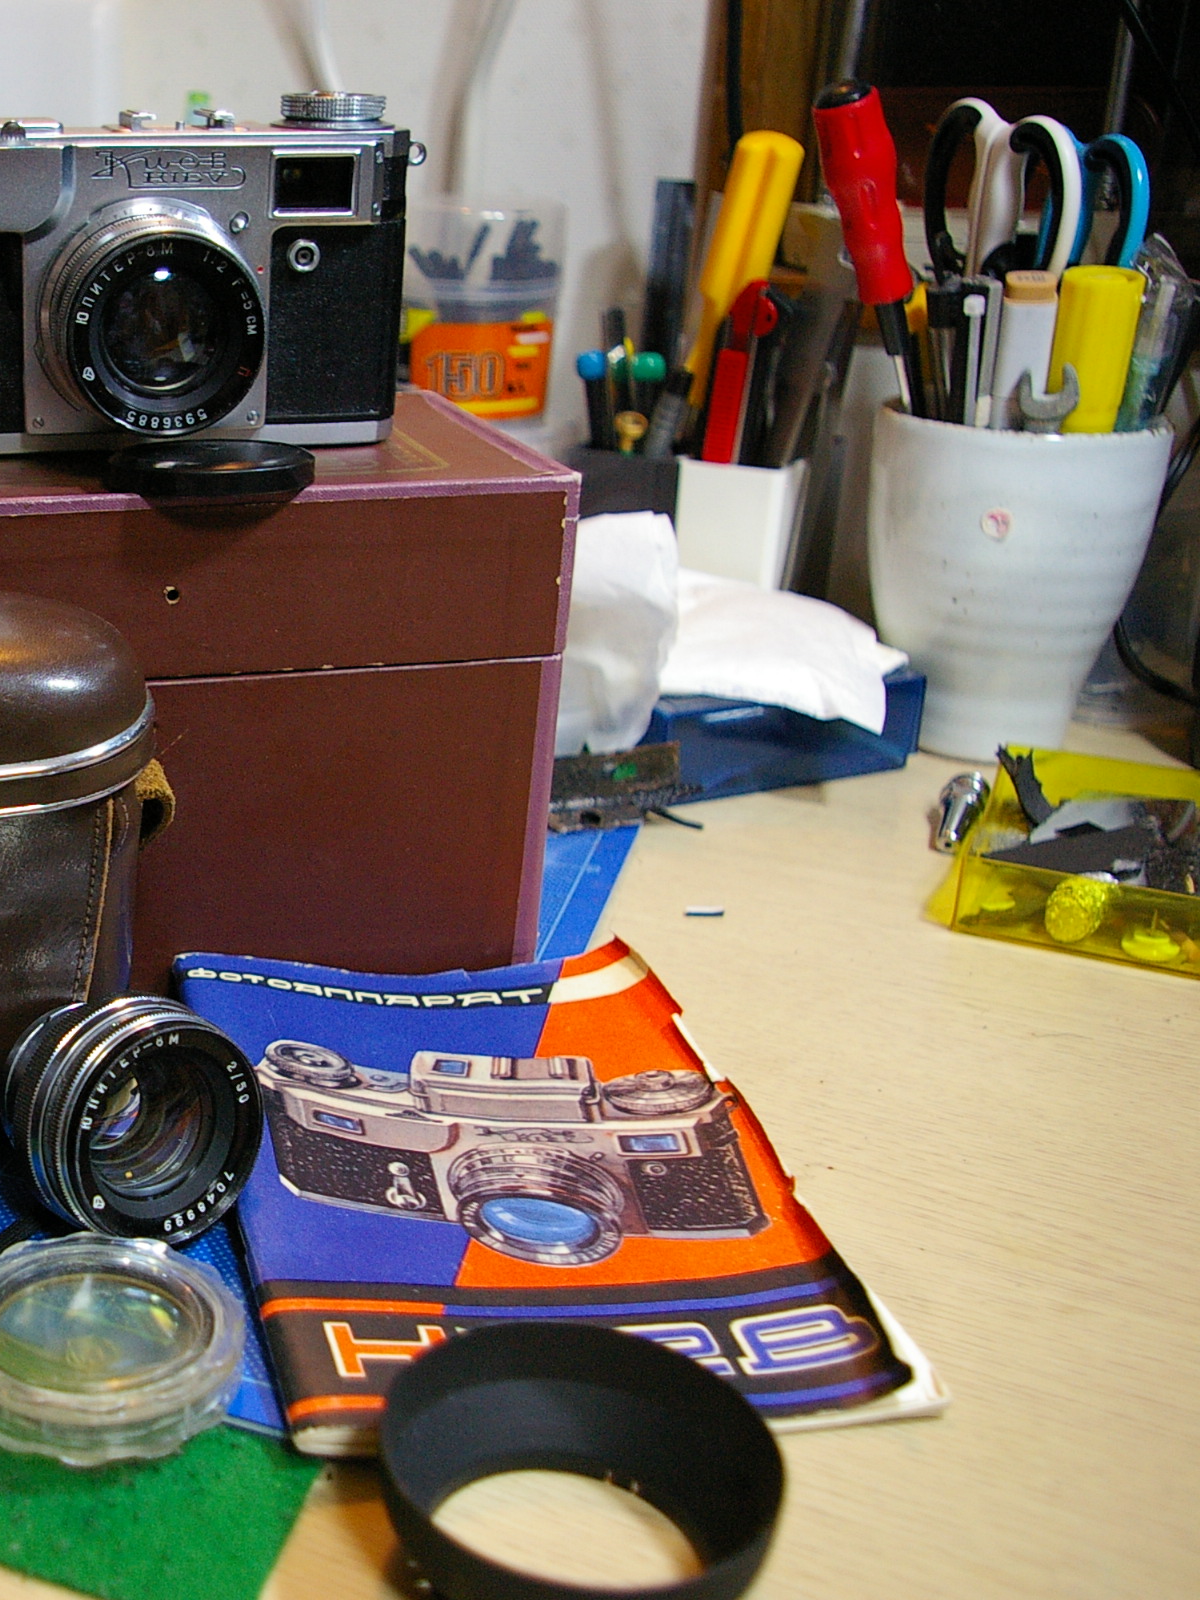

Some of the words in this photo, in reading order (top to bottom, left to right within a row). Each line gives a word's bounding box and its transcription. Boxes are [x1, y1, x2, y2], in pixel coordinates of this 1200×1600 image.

[143, 170, 228, 186] KIEV
[125, 407, 208, 429] 5936885
[226, 1060, 250, 1104] 2/50
